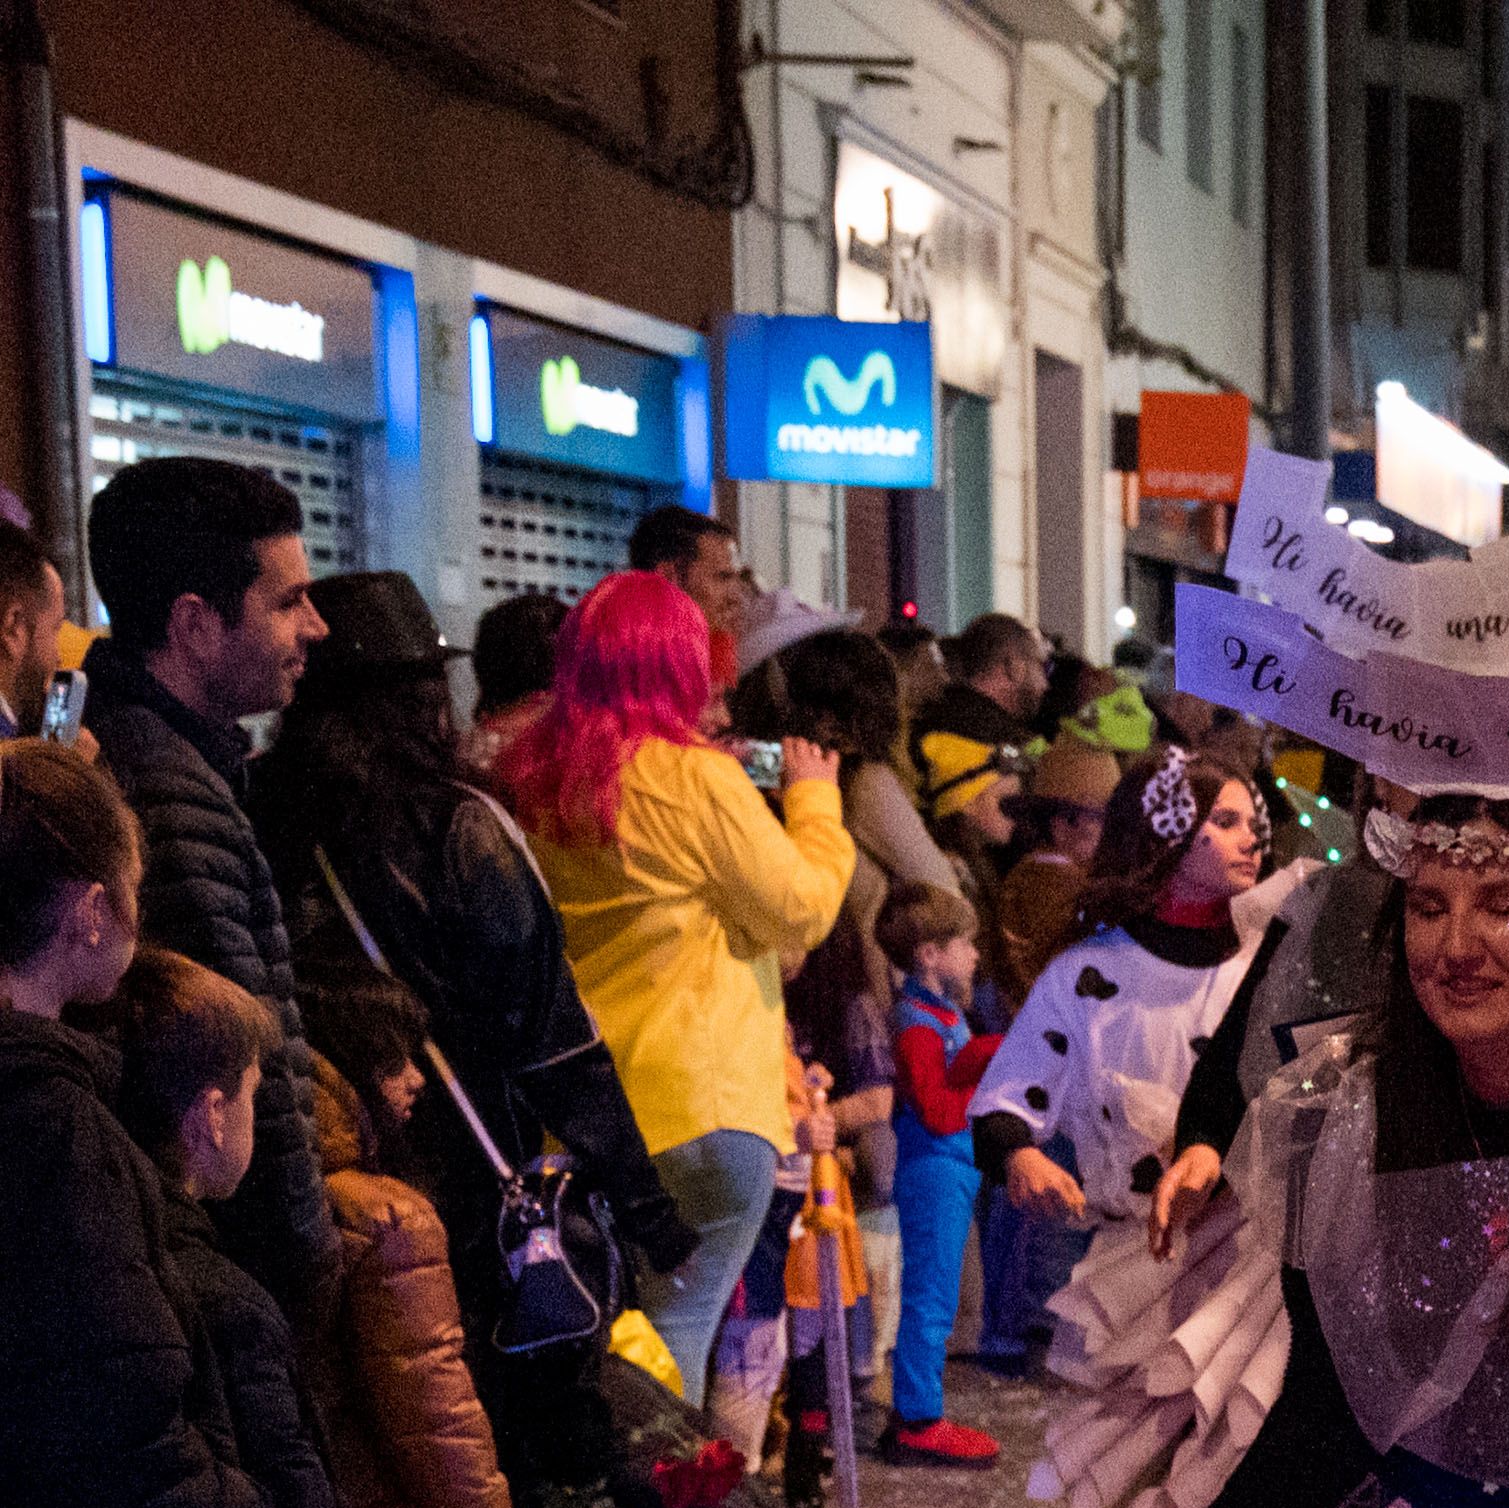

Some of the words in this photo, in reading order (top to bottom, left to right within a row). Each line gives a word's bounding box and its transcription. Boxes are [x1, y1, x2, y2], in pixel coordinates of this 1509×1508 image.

[777, 423, 921, 457] movistar
[1263, 516, 1308, 571] Hi
[1318, 567, 1411, 640] havia
[1224, 636, 1297, 694] Hi
[1329, 689, 1473, 758] havia
